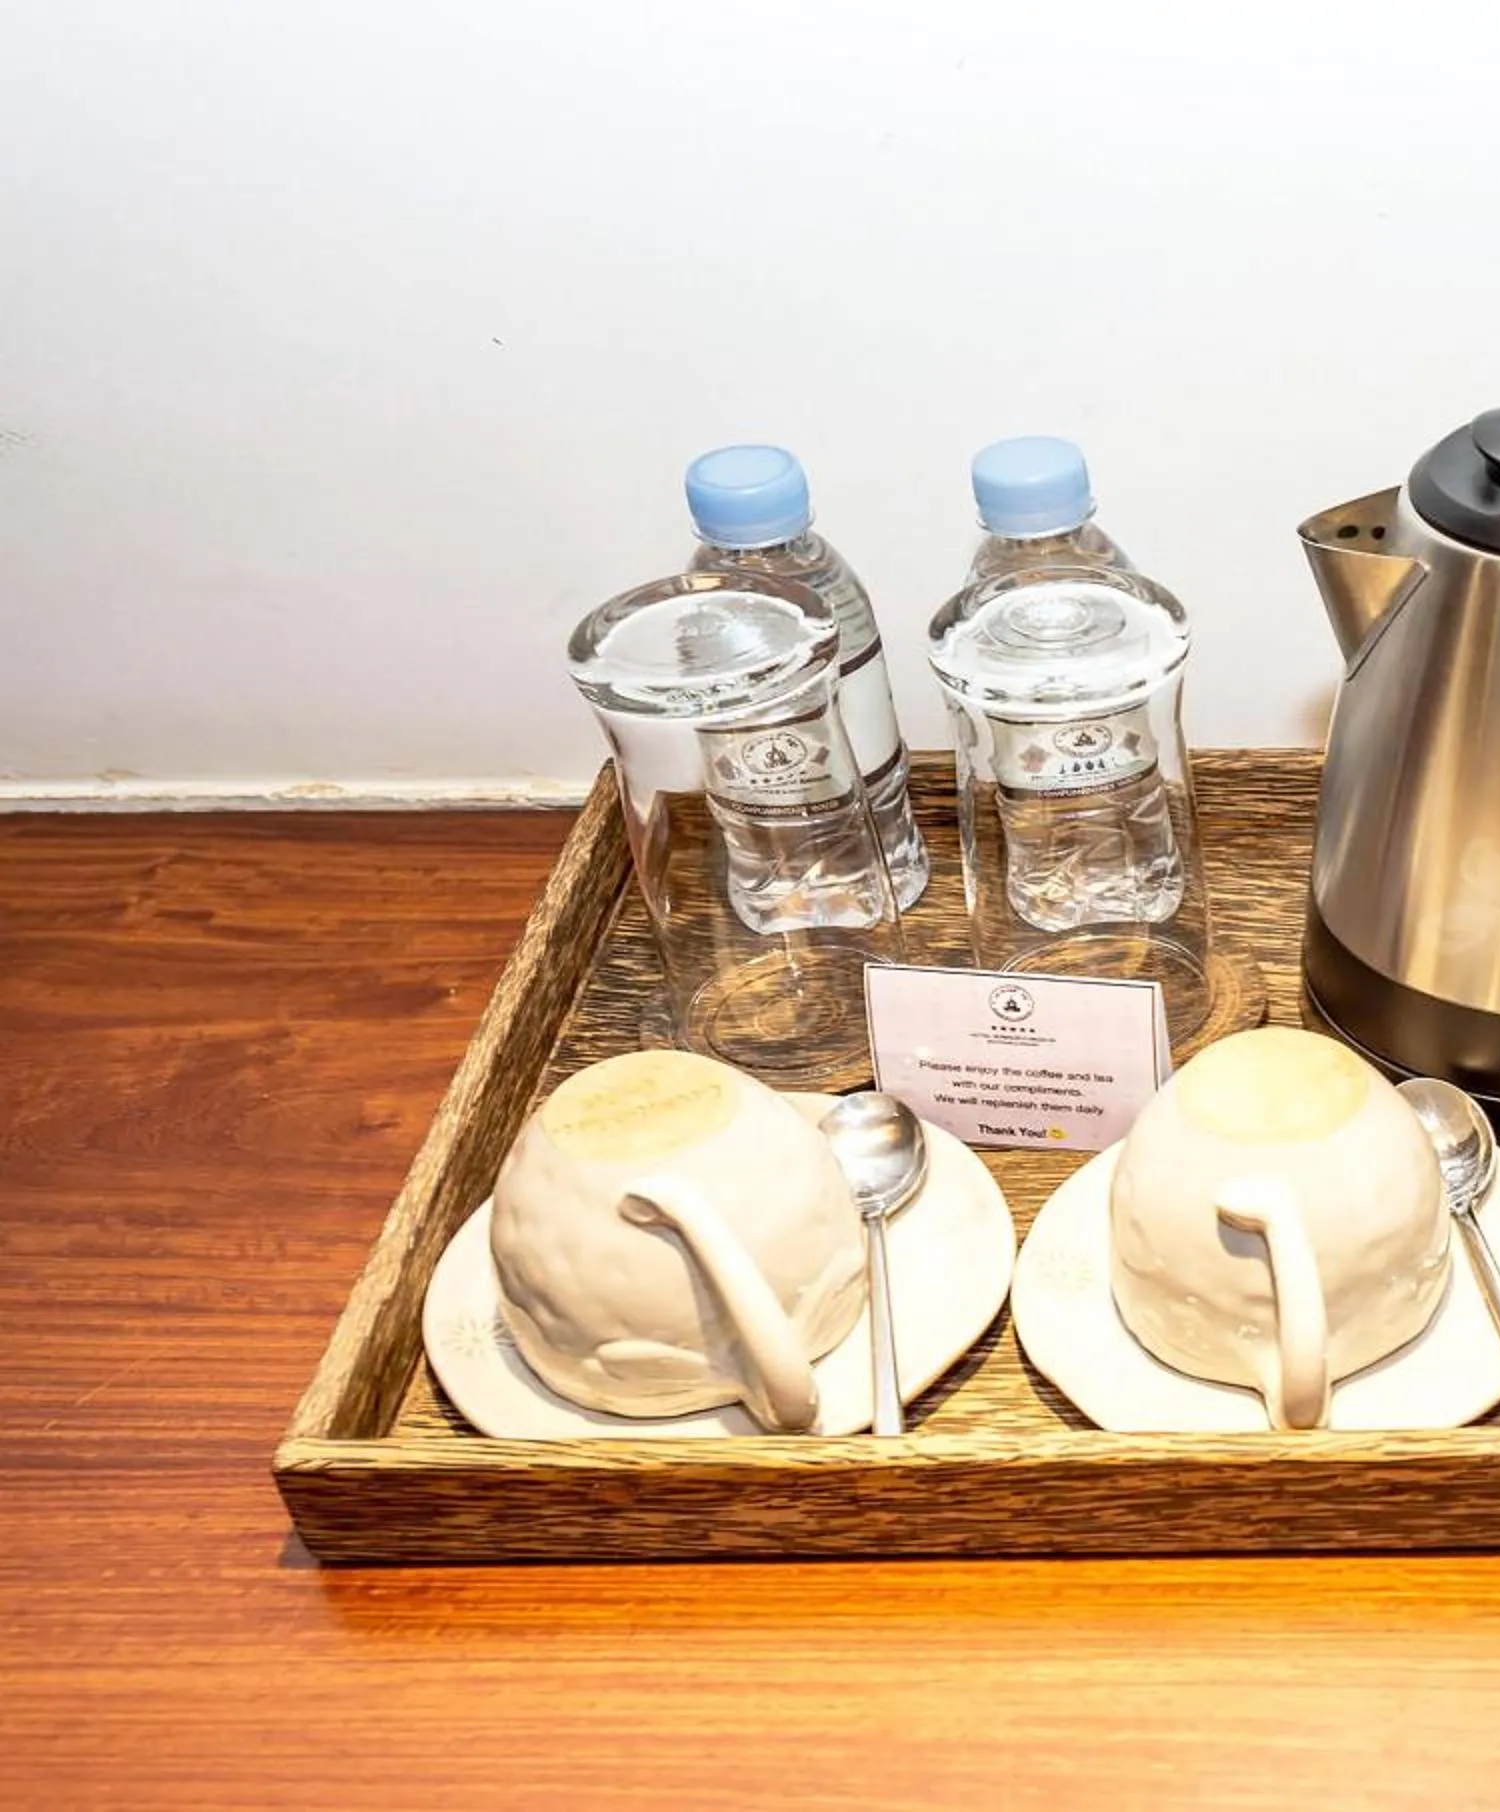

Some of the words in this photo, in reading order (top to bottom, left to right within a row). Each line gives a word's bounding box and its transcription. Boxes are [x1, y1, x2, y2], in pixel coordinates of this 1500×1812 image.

[919, 1059, 961, 1073] Please
[964, 1064, 998, 1077] enjoy
[1002, 1066, 1022, 1077] the
[1025, 1069, 1063, 1079] coffee
[1067, 1072, 1091, 1081] and
[1093, 1073, 1113, 1083] tea
[952, 1080, 976, 1090] with
[980, 1083, 999, 1091] our
[933, 1092, 955, 1103] We
[958, 1095, 978, 1105] will
[981, 1098, 1037, 1110] replenish
[1041, 1102, 1073, 1112] them
[1075, 1104, 1104, 1117] daily
[978, 1123, 1016, 1136] Thank
[1018, 1127, 1047, 1139] You!
